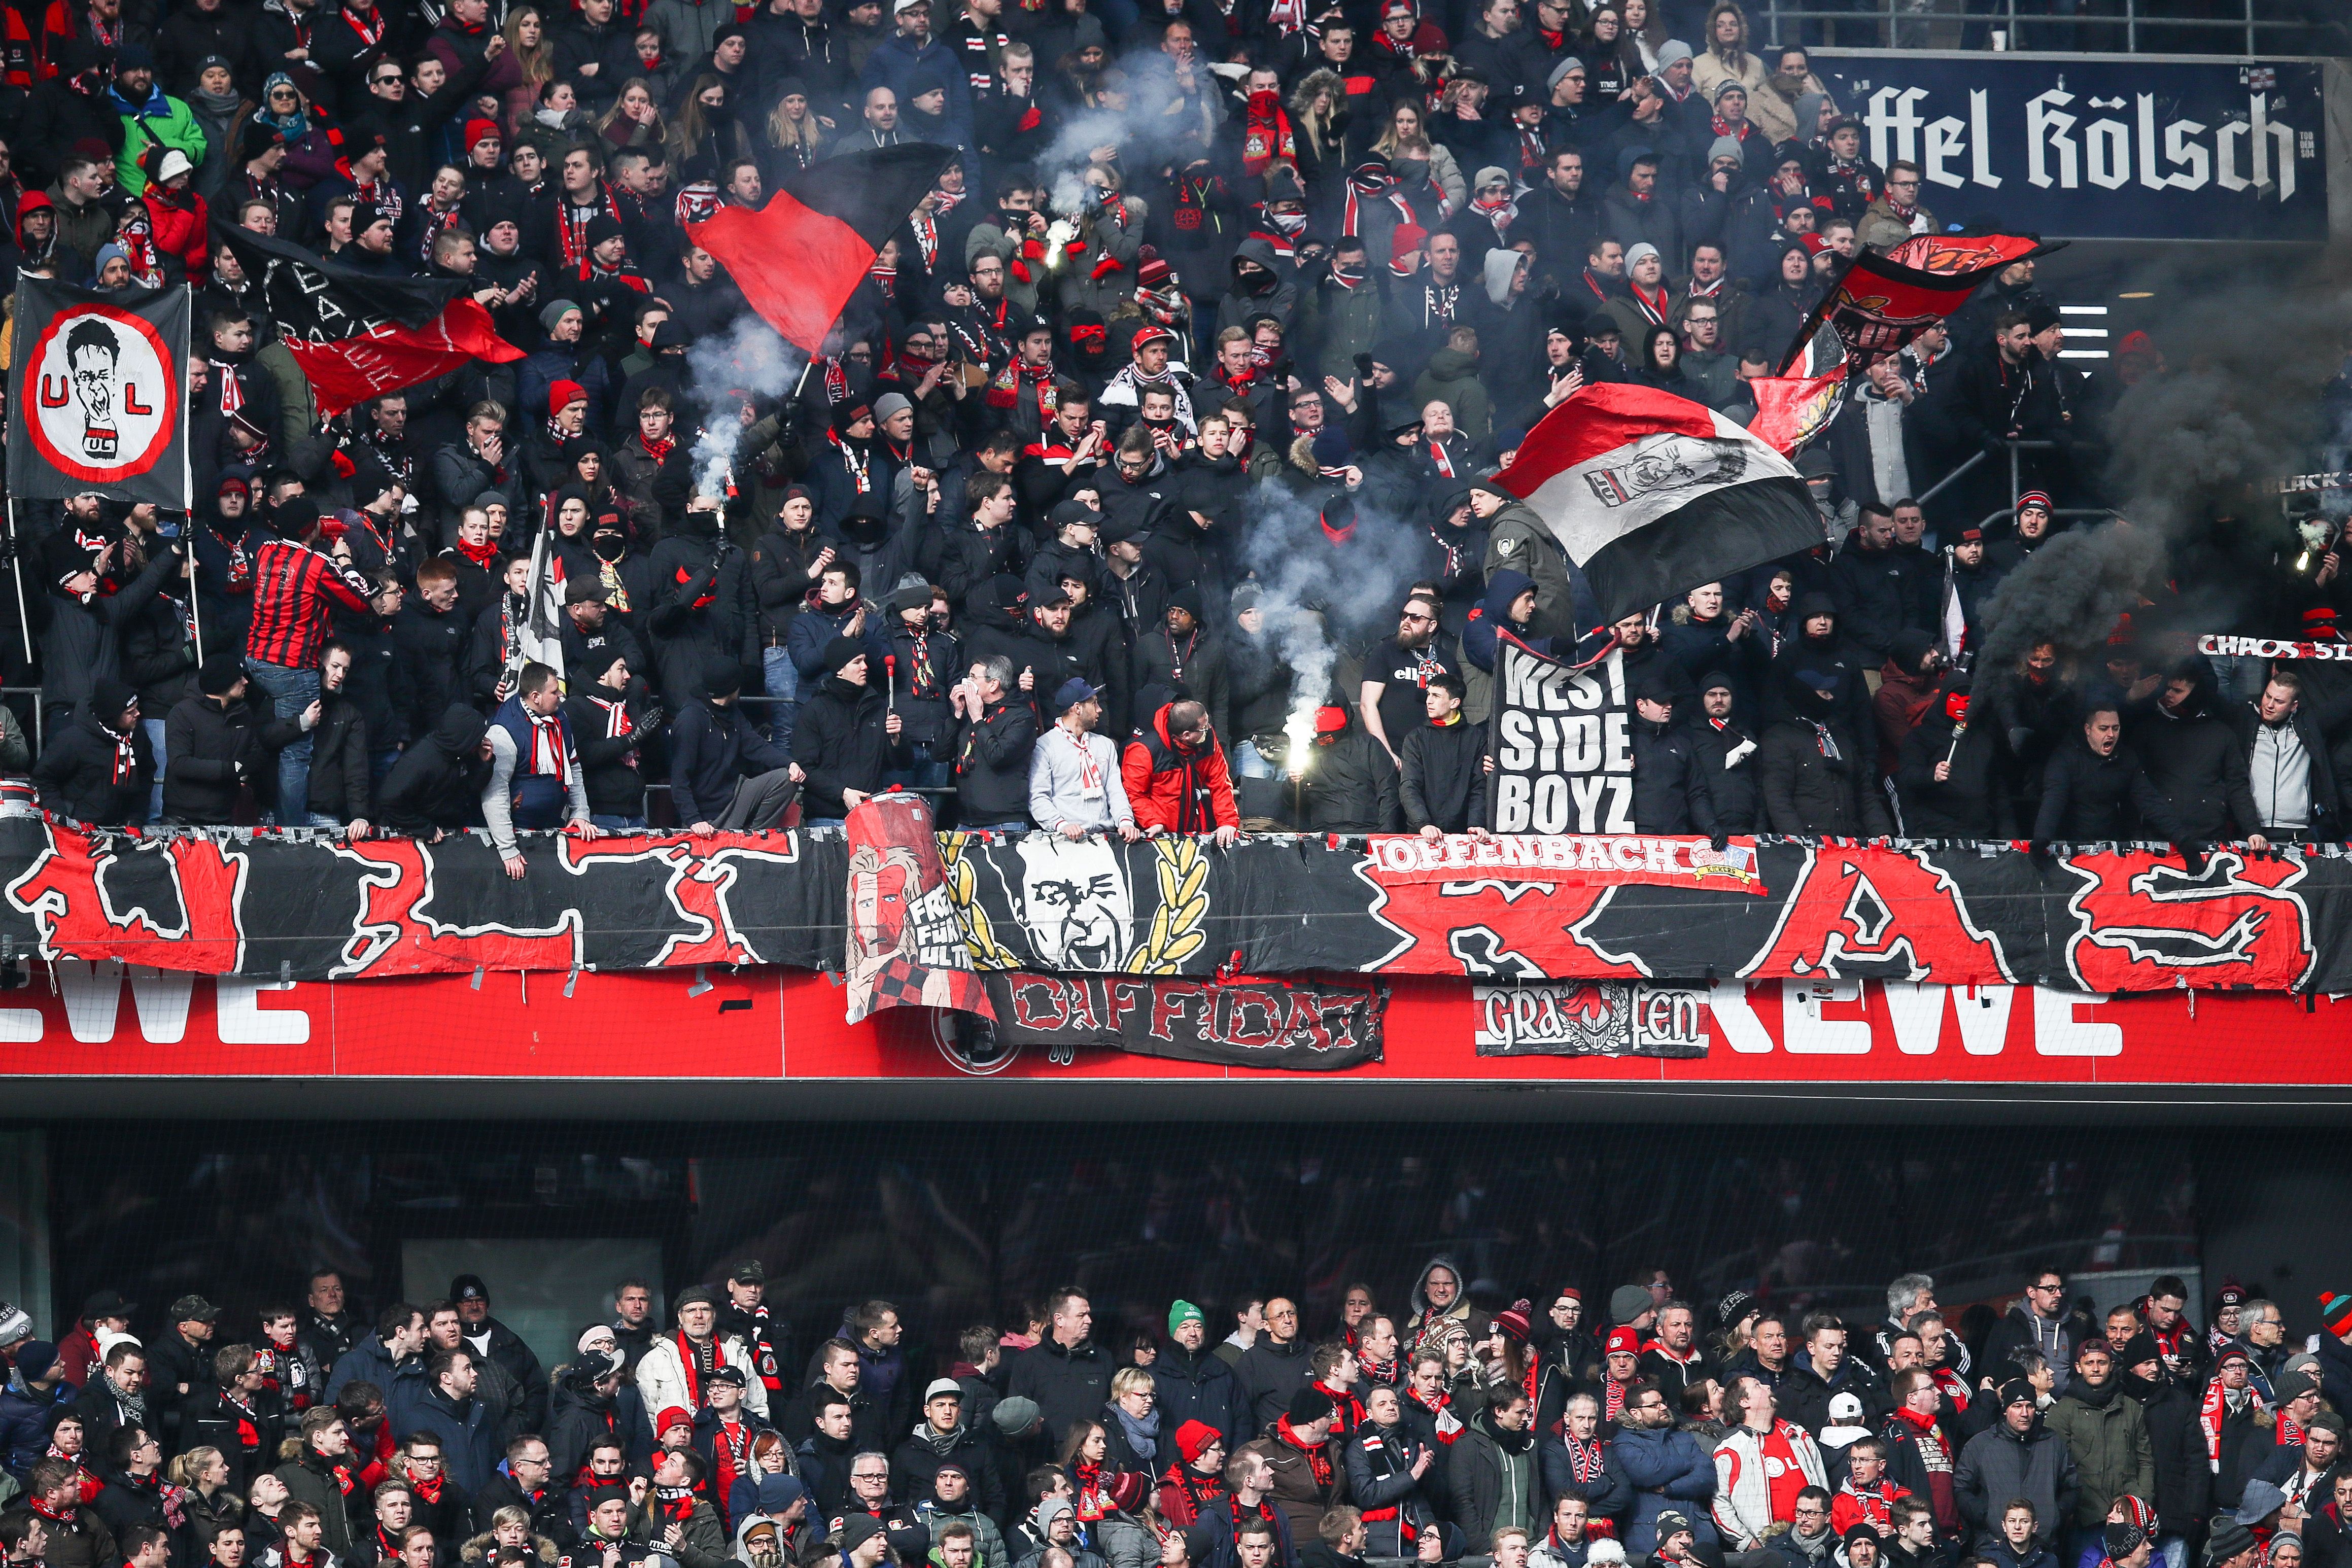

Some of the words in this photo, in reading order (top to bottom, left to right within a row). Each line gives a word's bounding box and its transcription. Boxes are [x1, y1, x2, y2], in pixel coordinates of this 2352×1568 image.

[1861, 85, 2003, 190] ffel
[2026, 87, 2296, 203] Kölsch
[1035, 315, 1048, 325] LA
[89, 437, 111, 450] UL
[2197, 634, 2302, 659] CHAOS
[1505, 644, 1626, 712] WEST
[1499, 711, 1632, 773] SIDE
[1496, 775, 1636, 835] BOYZ
[1382, 832, 1680, 874] OFFENBACH
[1706, 866, 1736, 874] KICKERS
[2284, 1420, 2301, 1446] YER
